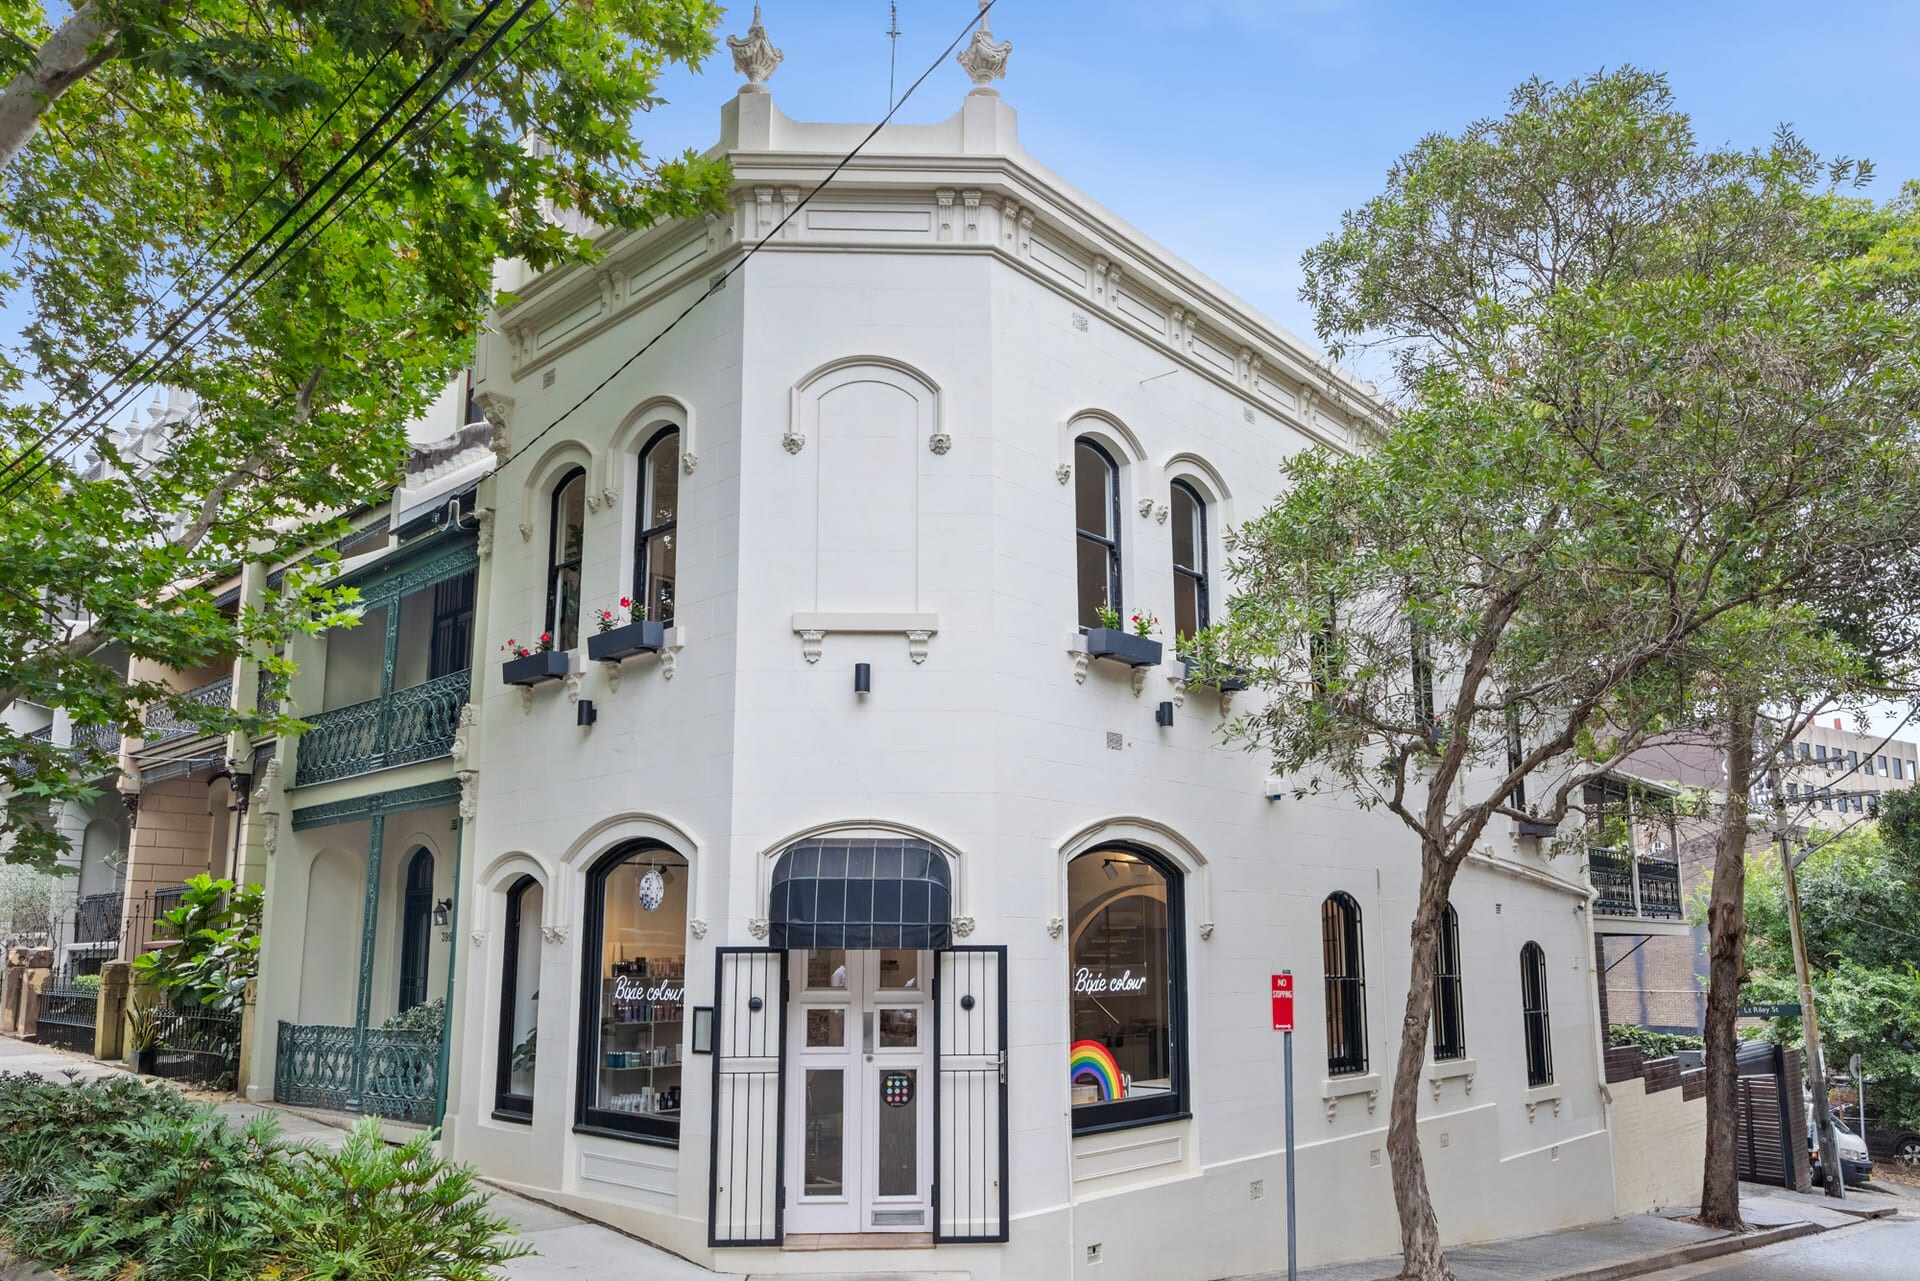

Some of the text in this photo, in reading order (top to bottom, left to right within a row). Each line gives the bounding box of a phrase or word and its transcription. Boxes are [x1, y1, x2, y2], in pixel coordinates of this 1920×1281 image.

[1074, 967, 1146, 995] Bixie colour
[1277, 978, 1287, 987] NO
[615, 975, 685, 1003] Bixie colour
[1272, 990, 1293, 999] STOPPING
[1771, 1005, 1779, 1013] St
